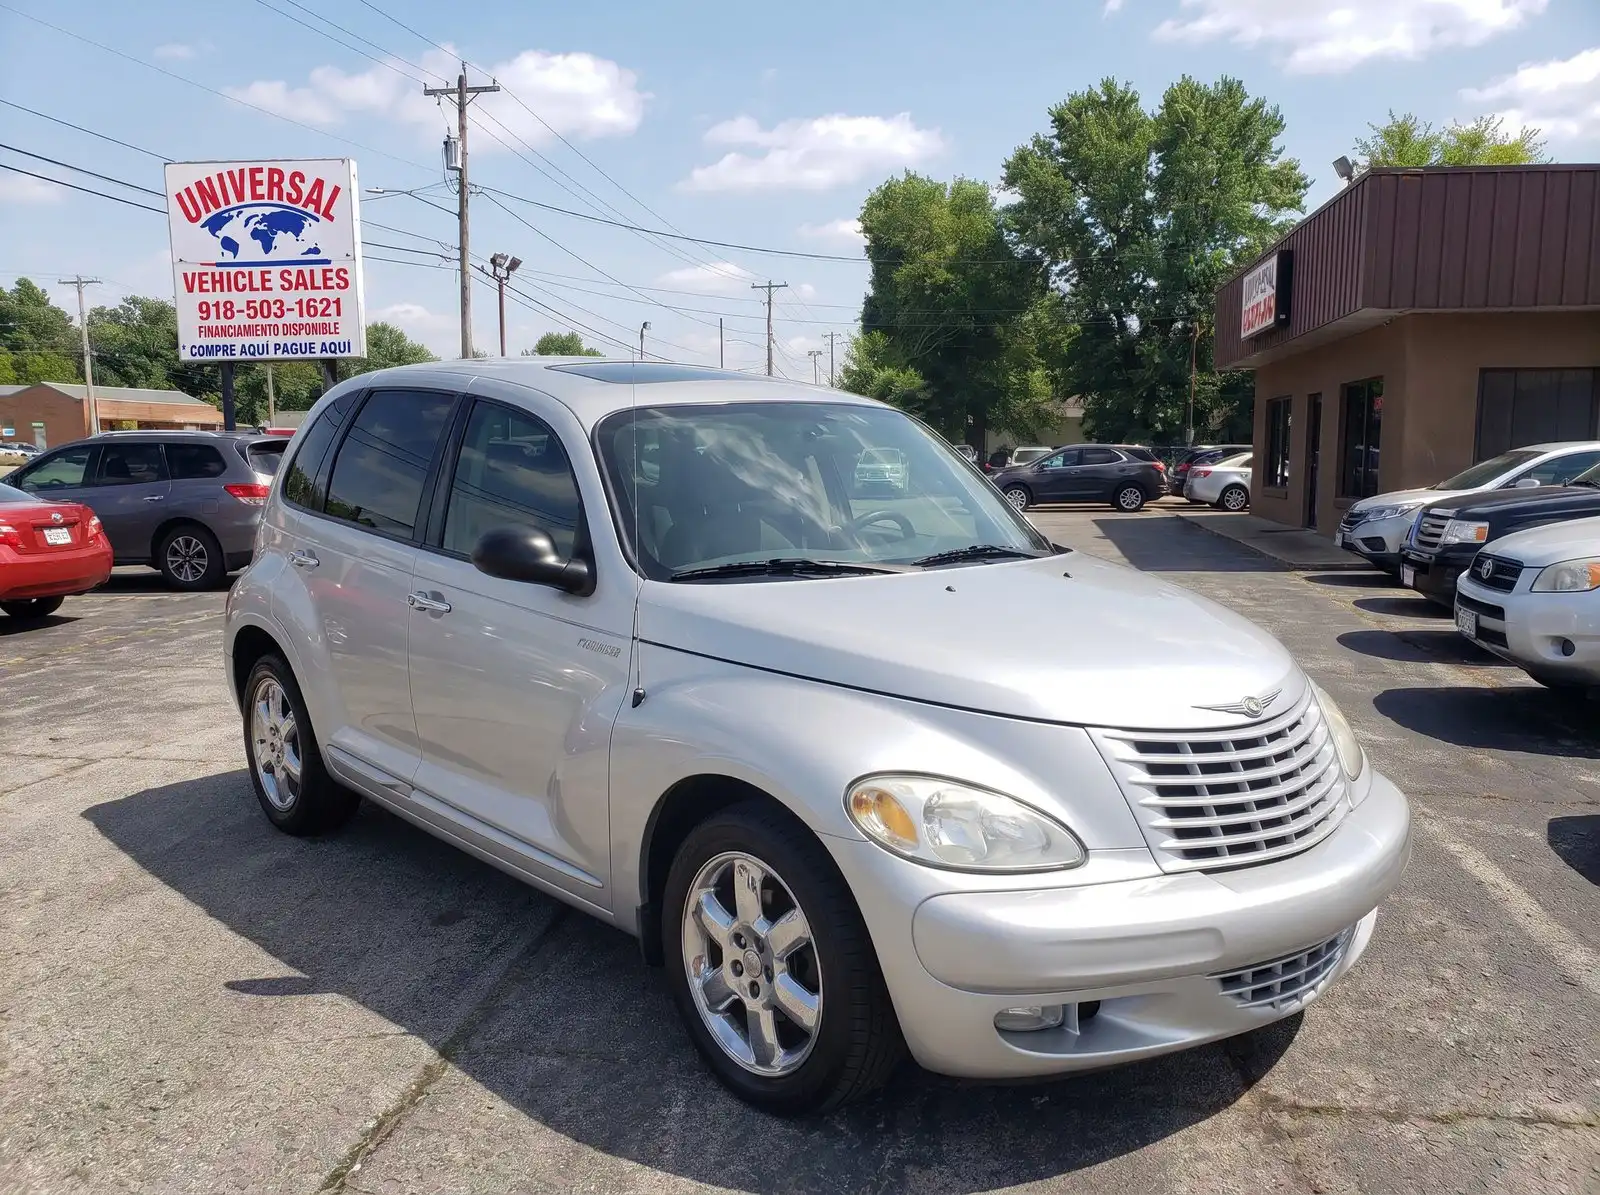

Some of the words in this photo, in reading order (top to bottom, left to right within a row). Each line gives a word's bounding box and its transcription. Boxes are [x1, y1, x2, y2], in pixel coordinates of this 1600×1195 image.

[175, 167, 341, 223] UNIVERSAL
[183, 270, 273, 293] VEHICLE
[279, 267, 349, 291] SALES
[198, 297, 342, 321] 918-503-1621
[198, 323, 279, 338] FINANCIAMIENTO
[282, 322, 340, 336] DISPONIBLE
[190, 344, 236, 357] COMPRE
[240, 340, 269, 356] AQUÍ
[274, 341, 316, 355] PAGUE
[319, 338, 350, 354] AQUÍ
